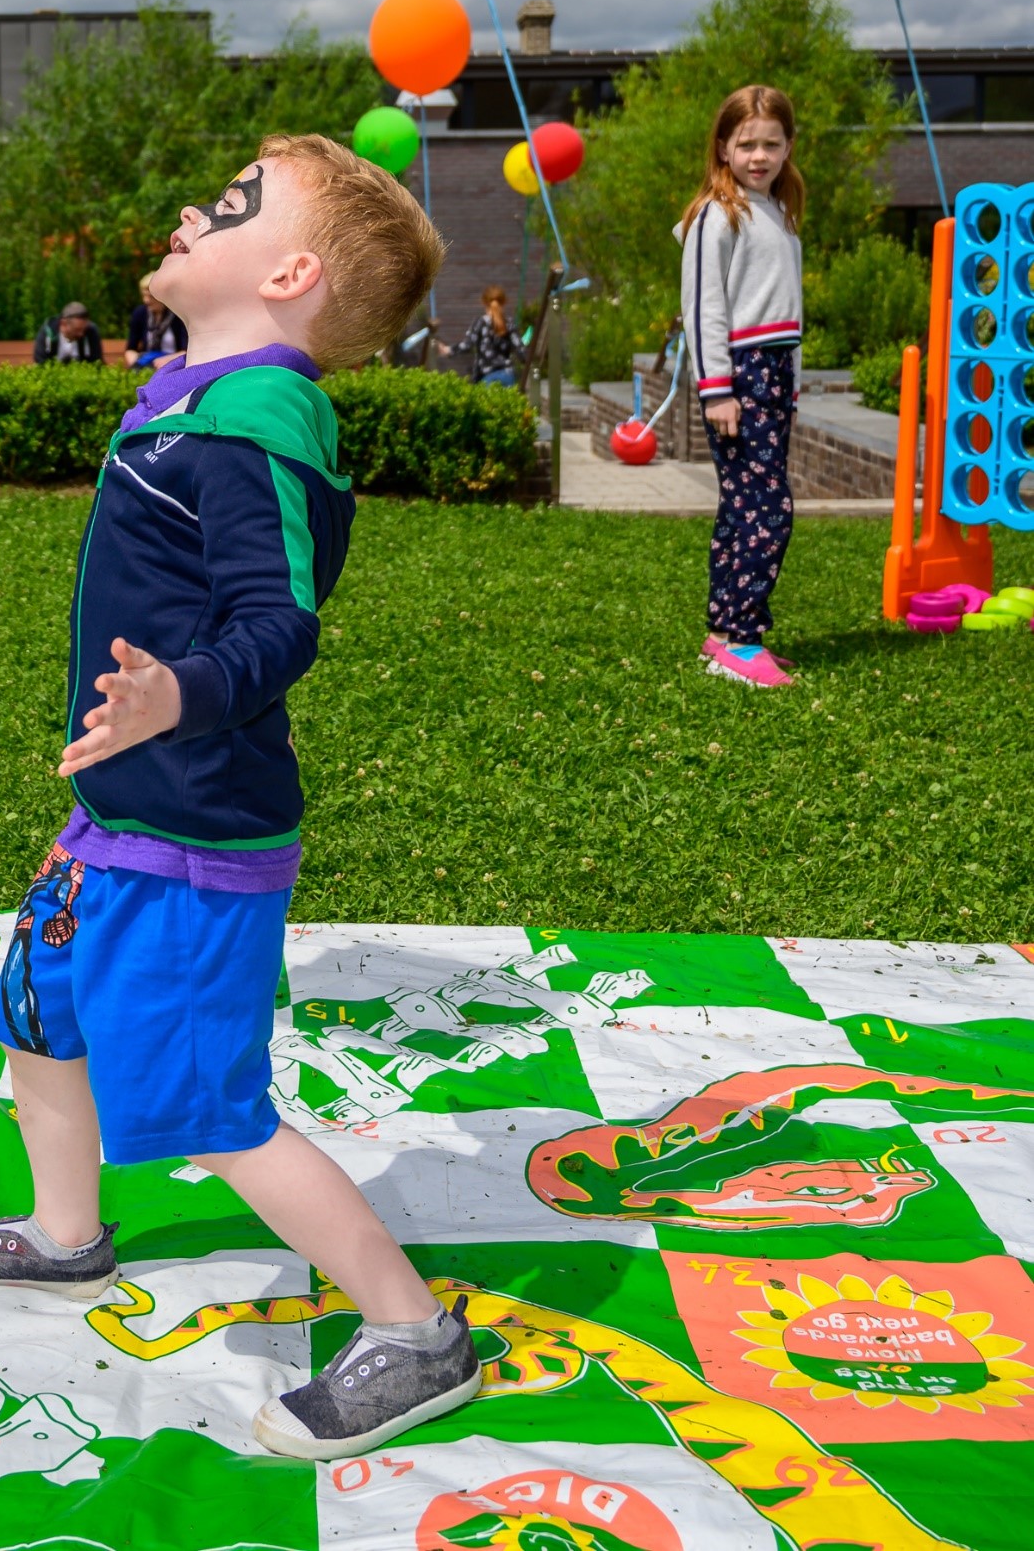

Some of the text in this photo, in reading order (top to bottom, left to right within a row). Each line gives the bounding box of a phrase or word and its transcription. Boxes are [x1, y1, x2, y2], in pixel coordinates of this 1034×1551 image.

[306, 1002, 355, 1024] 15
[636, 1122, 691, 1148] 21
[932, 1125, 1007, 1144] 20
[686, 1260, 765, 1287] 34
[812, 1313, 919, 1331] next go
[792, 1327, 955, 1348] backwards
[846, 1348, 923, 1361] Move
[834, 1367, 883, 1383] leg
[867, 1364, 911, 1373] or
[857, 1381, 952, 1394] Stand
[920, 1376, 957, 1384] on
[331, 1457, 415, 1493] 40
[775, 1455, 869, 1488] 39
[457, 1476, 628, 1523] DICE
